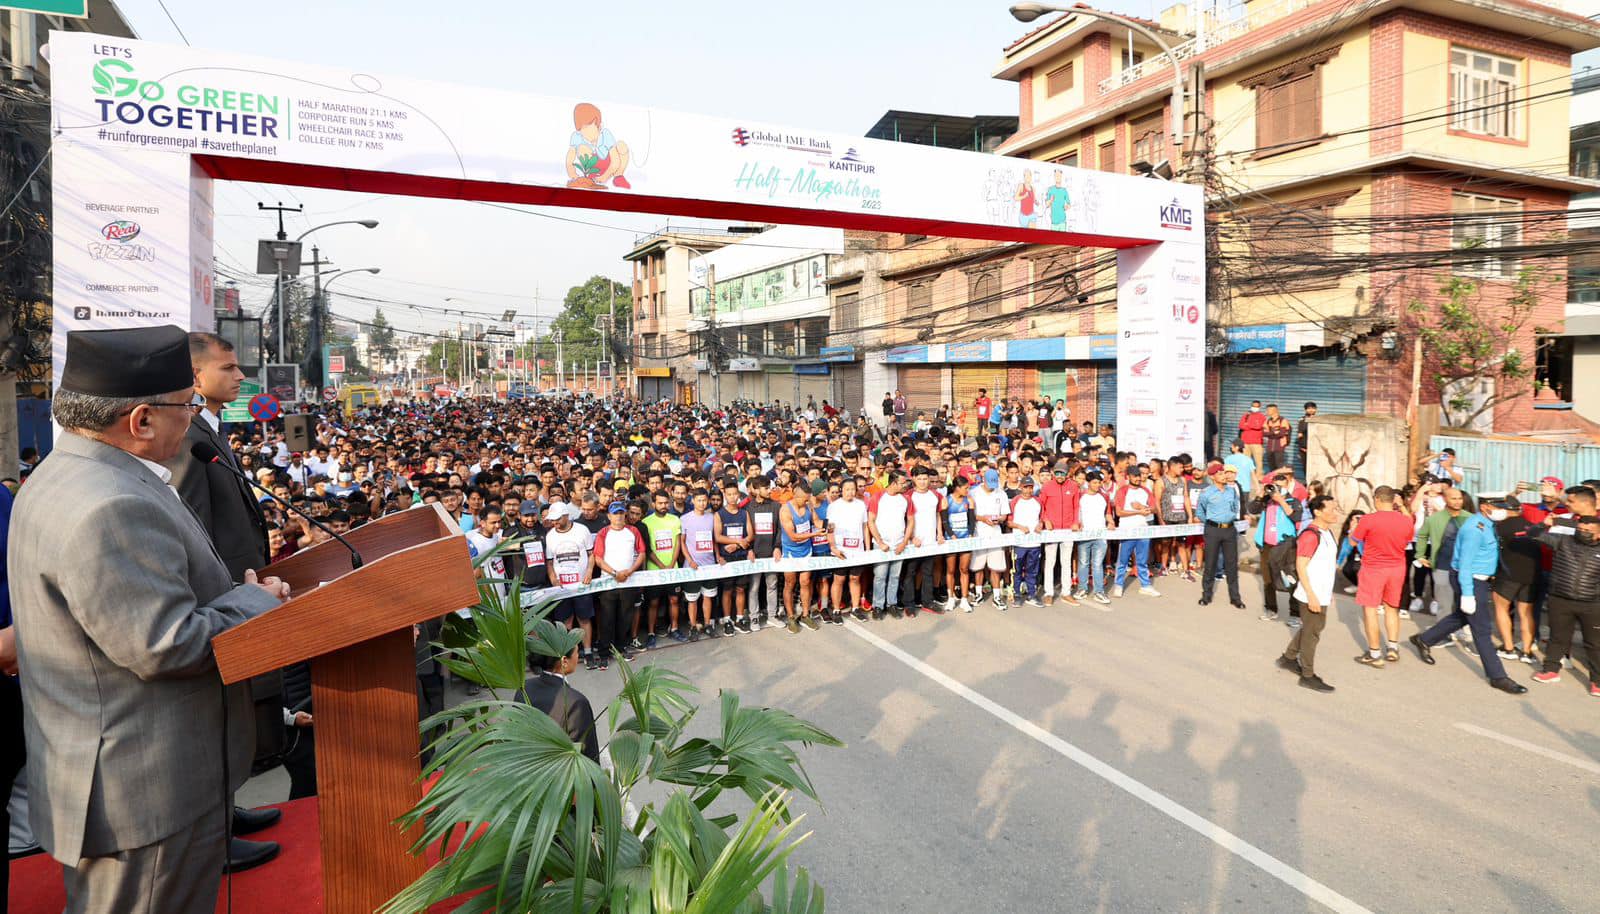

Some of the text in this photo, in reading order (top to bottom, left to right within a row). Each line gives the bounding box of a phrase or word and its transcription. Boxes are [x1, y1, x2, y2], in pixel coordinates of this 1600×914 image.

[93, 44, 132, 59] LET'S
[177, 85, 278, 115] GREEN
[298, 99, 319, 110] HALF
[322, 102, 367, 115] MARATHON
[389, 110, 407, 120] KMS
[95, 98, 278, 139] TOGETHER
[298, 111, 348, 125] CORPORATE
[350, 117, 367, 126] RUN
[376, 120, 395, 130] KMS
[298, 122, 353, 136] WHEELCHAIR
[355, 129, 376, 139] RACE
[386, 132, 404, 142] KMS
[751, 131, 782, 143] Global
[785, 135, 806, 146] IME
[809, 138, 832, 150] Bank
[98, 128, 277, 156] #runforgreennepal #savetheplanet
[298, 134, 336, 146] COLLEGE
[338, 138, 356, 148] RUN
[365, 141, 384, 151] KMS
[829, 160, 875, 174] KANTIPUR
[86, 203, 159, 214] BEVERAGE PARTNER
[861, 199, 881, 210] 2023
[1160, 205, 1192, 225] KMG
[106, 223, 138, 240] Real
[86, 284, 159, 293] COMMERCE PARTNER
